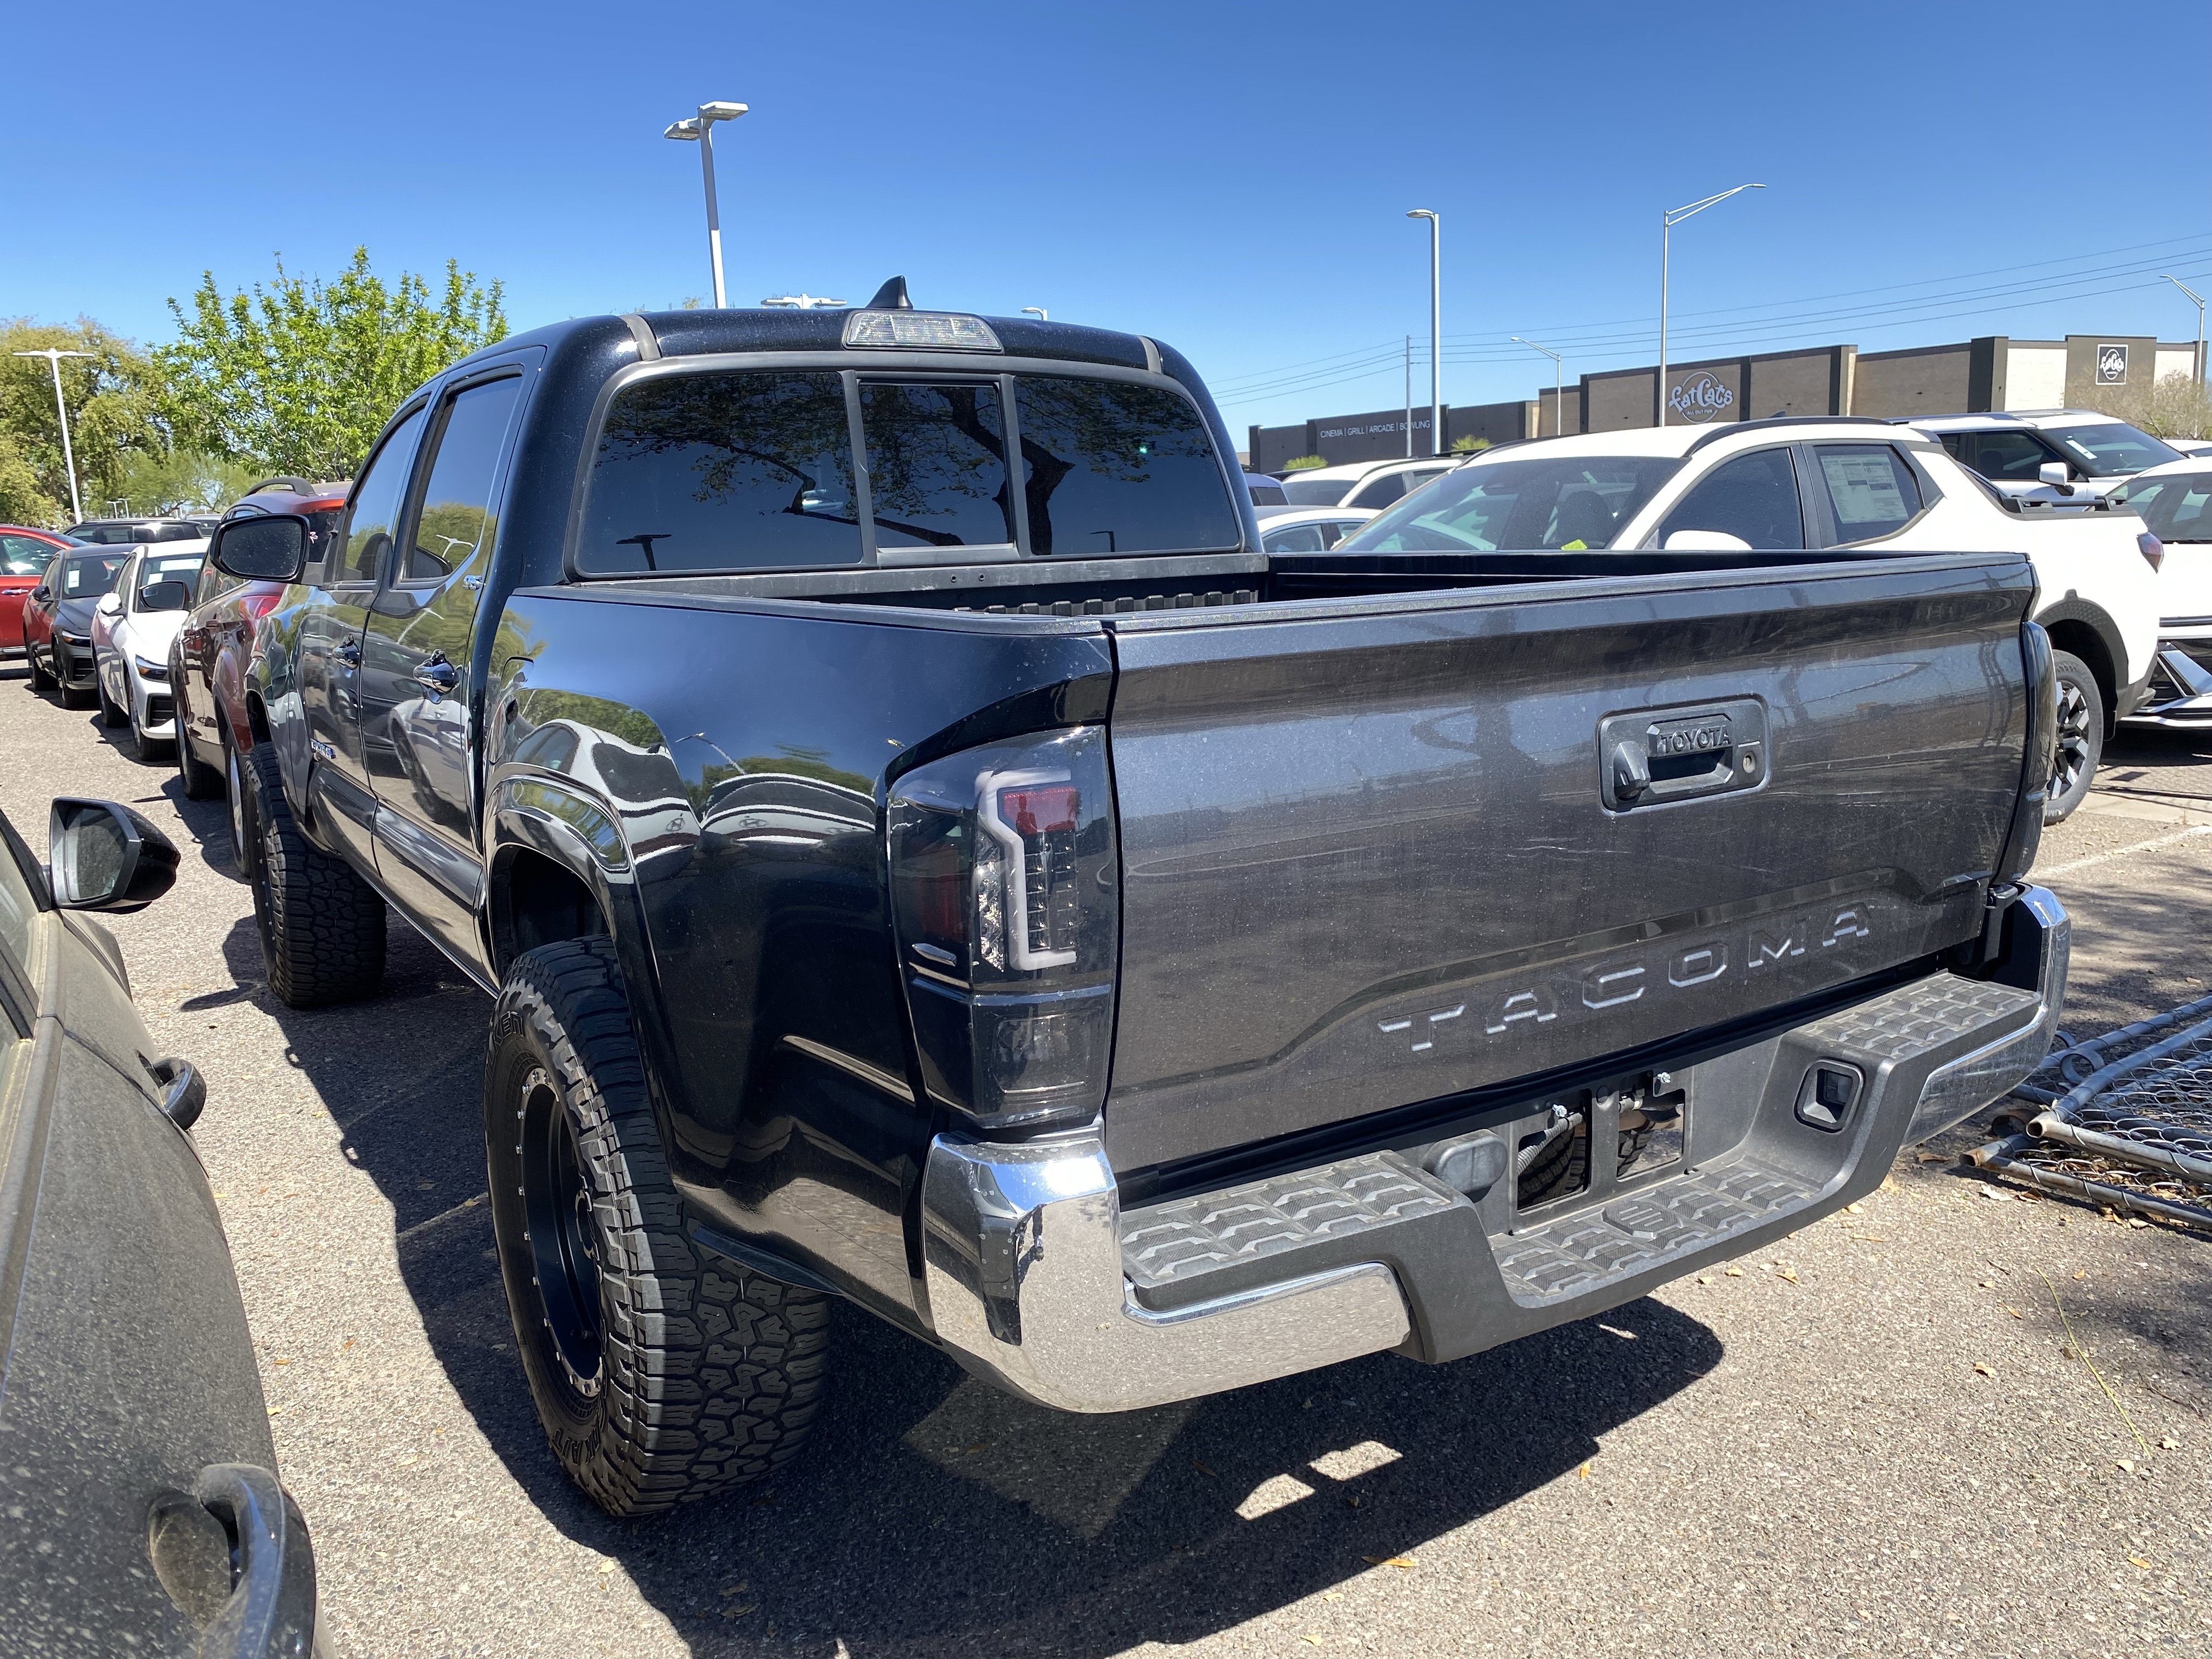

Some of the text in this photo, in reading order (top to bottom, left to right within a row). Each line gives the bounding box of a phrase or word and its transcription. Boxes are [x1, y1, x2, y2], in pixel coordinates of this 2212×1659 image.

[1320, 428, 1343, 438] CINEMA
[1347, 427, 1365, 435] GRILL
[1369, 423, 1395, 433] ARCADE
[1659, 725, 1732, 754] TOYOTA
[1377, 901, 1870, 1052] TACOMA
